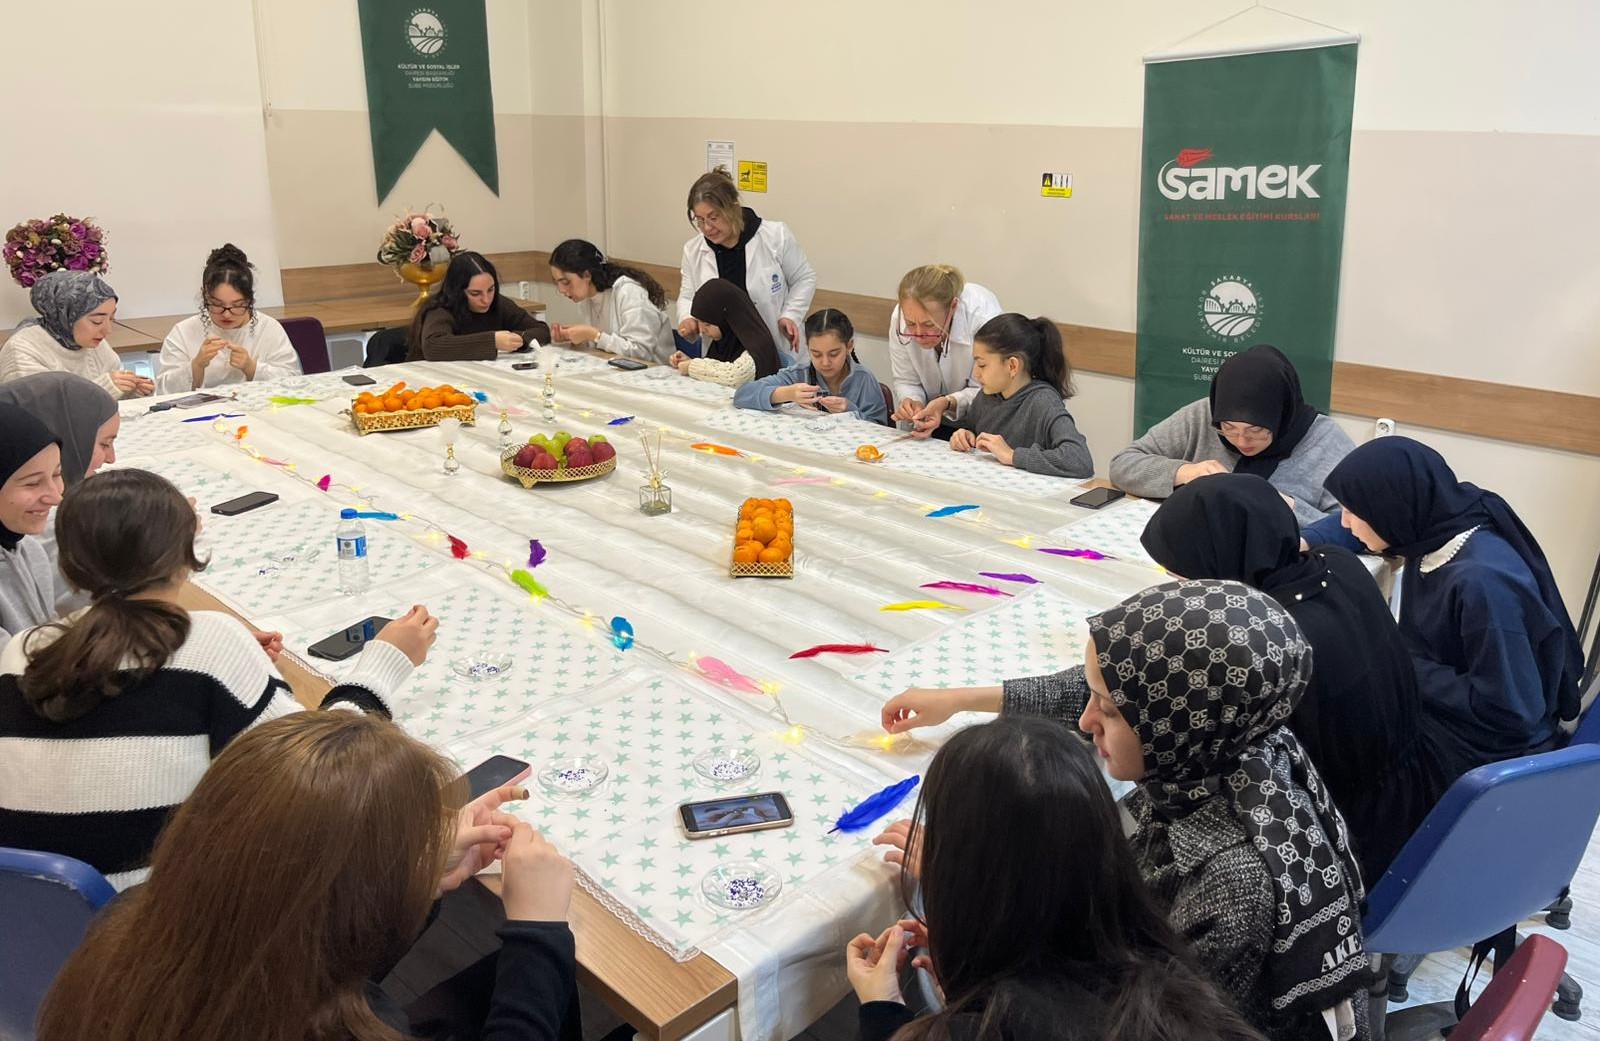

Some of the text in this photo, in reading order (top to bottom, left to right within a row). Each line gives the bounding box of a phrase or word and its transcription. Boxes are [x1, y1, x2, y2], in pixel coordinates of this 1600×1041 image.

[1210, 274, 1252, 288] SAKARYA
[1182, 347, 1210, 356] KÜLTÜR
[1211, 349, 1222, 357] VE
